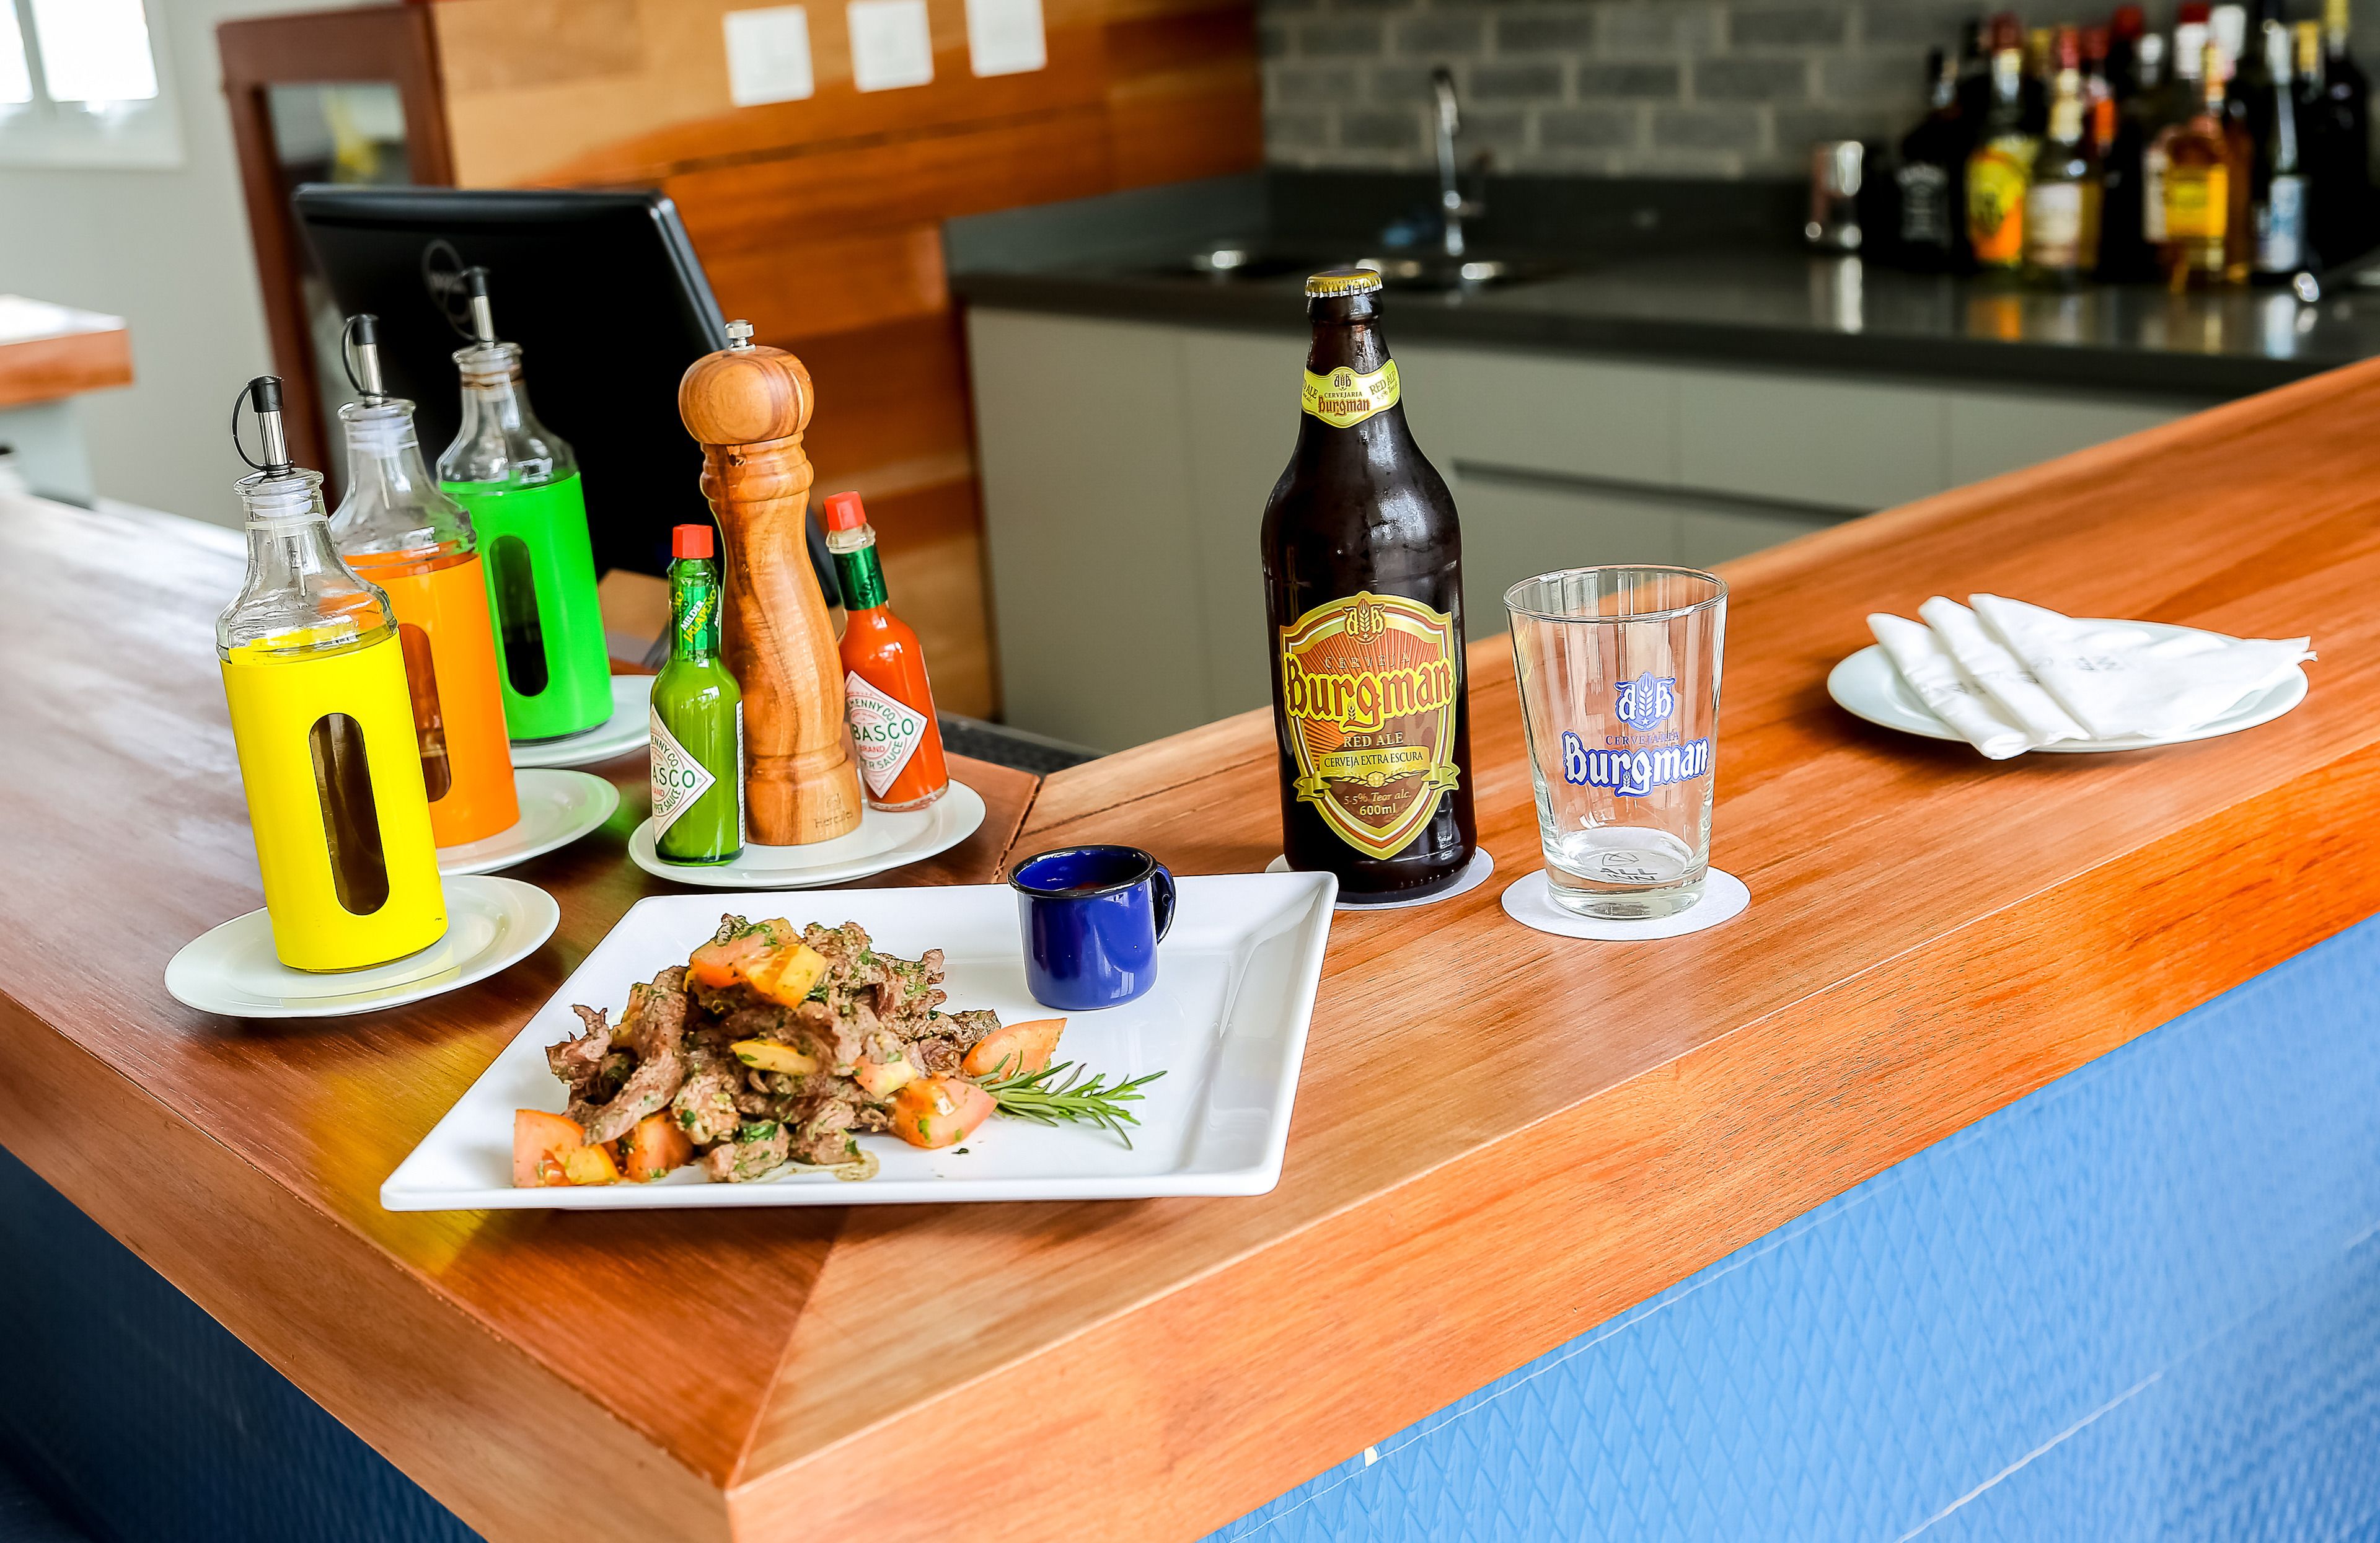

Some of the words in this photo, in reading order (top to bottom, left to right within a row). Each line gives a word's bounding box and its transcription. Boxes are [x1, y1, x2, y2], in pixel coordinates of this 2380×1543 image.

[1369, 379, 1386, 395] RED
[1318, 395, 1370, 416] Burgman
[681, 599, 705, 631] MILDER
[1325, 651, 1411, 669] CERVEJA
[1285, 654, 1452, 731] Burgman
[852, 718, 914, 742] BASCO
[1343, 735, 1372, 748] RED
[1376, 732, 1404, 746] ALE
[1606, 732, 1680, 745] CERVEJARIA
[877, 741, 903, 769] SAUCE
[1324, 755, 1361, 769] CERVEJA
[1361, 754, 1389, 766] EXTRA
[1390, 751, 1424, 763] ESCURA
[1563, 730, 1709, 798] Burgman
[653, 765, 695, 789] ASCO
[664, 788, 682, 811] SAUCE
[1394, 788, 1413, 800] alc.
[1359, 802, 1397, 816] 600ml
